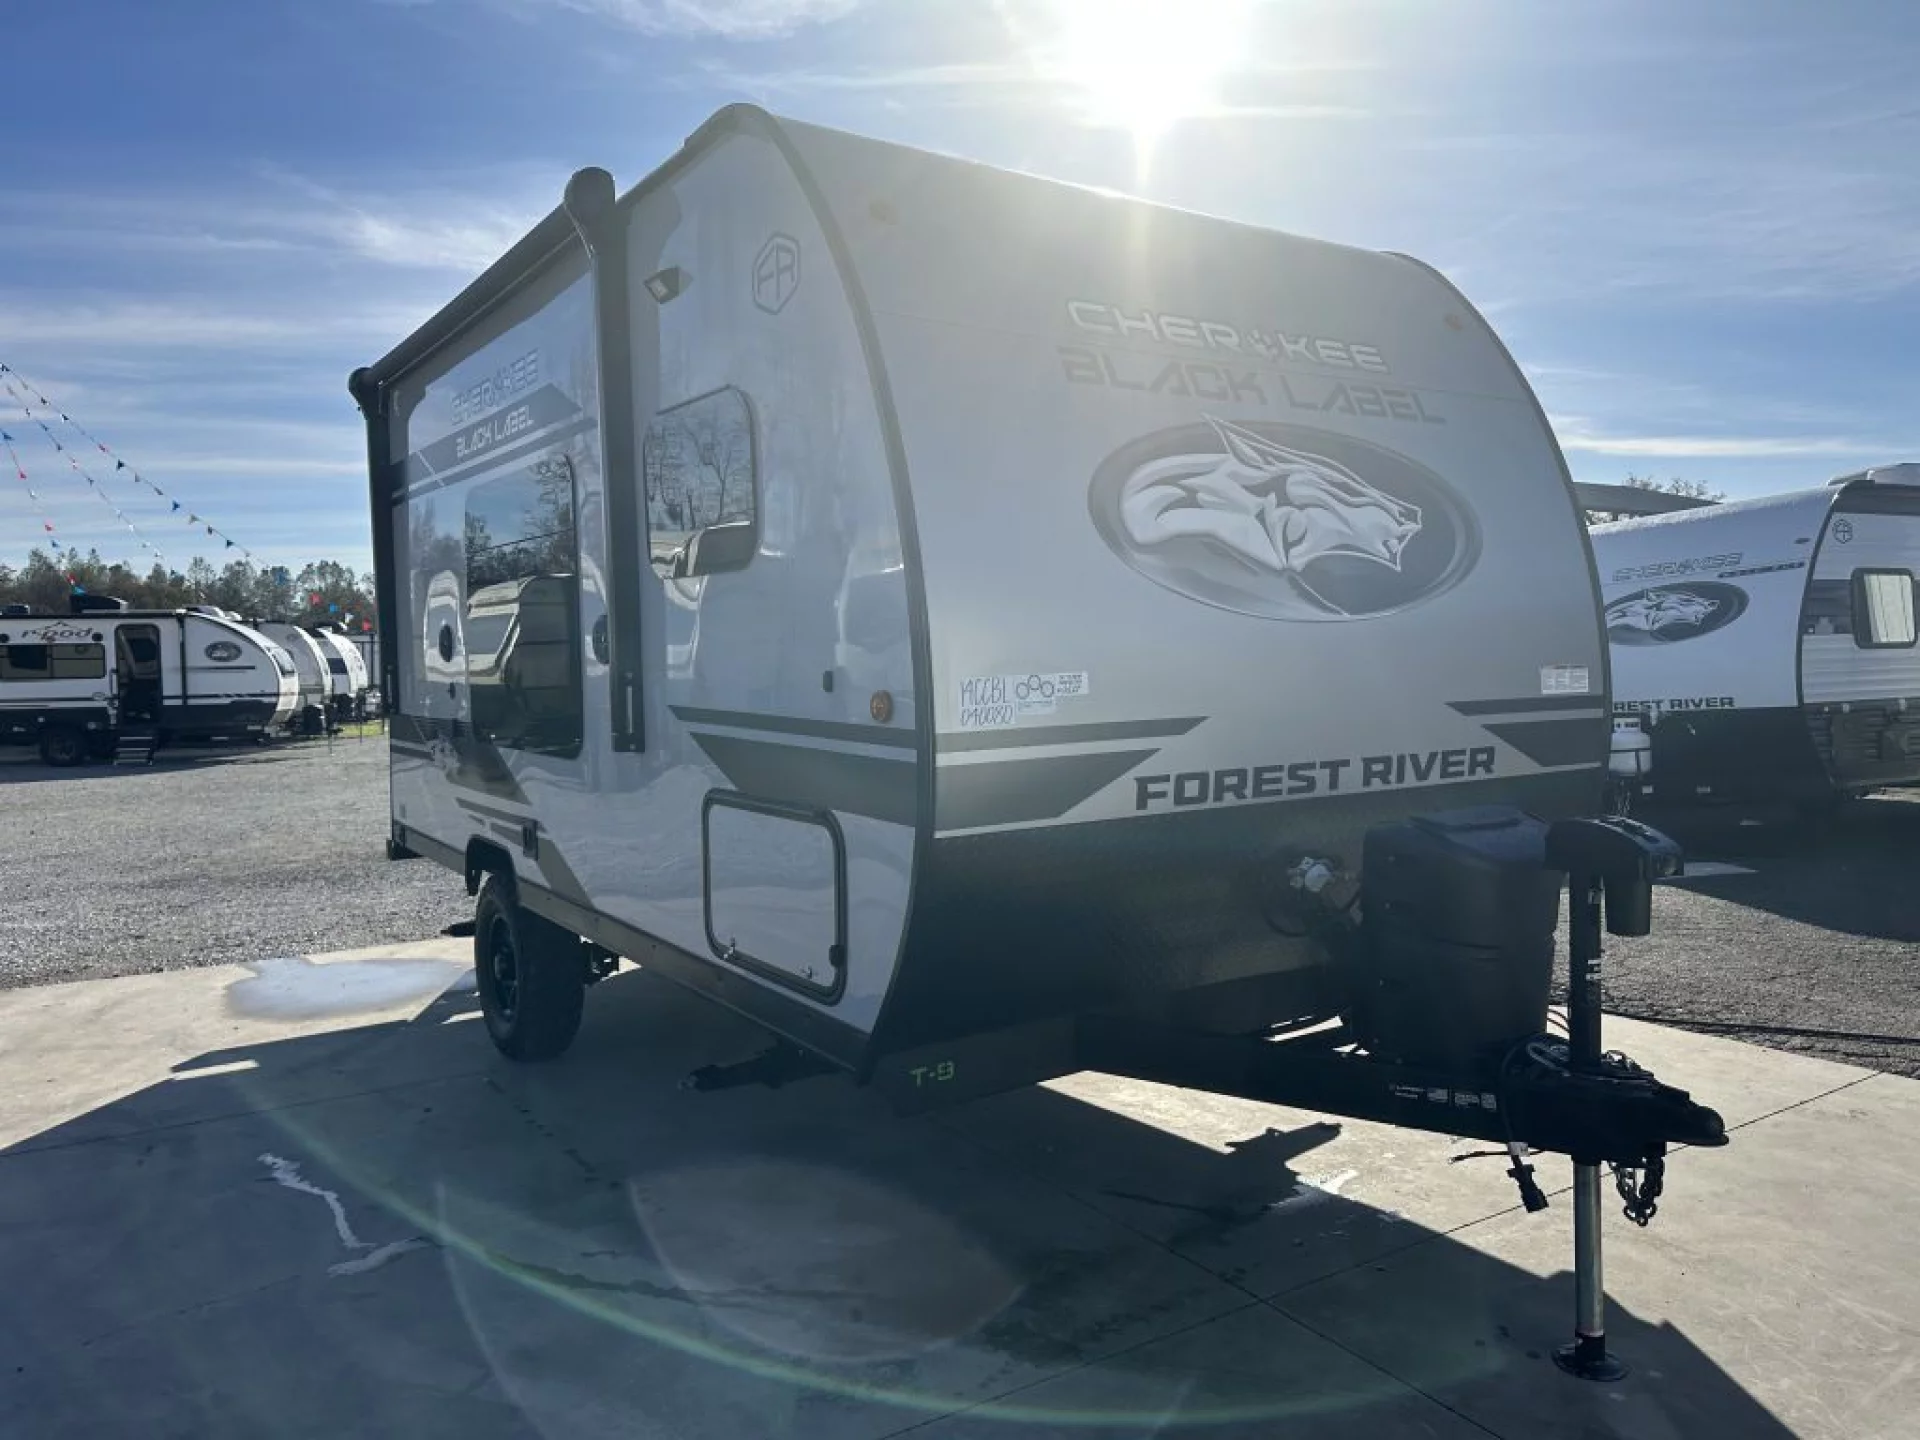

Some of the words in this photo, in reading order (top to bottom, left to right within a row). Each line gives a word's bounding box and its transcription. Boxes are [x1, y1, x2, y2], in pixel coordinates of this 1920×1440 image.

[1056, 345, 1270, 404] BLACK
[1278, 372, 1447, 424] LABEL
[456, 420, 493, 458] BLACK
[493, 404, 535, 441] LABEL
[1670, 696, 1735, 710] RIVER
[1134, 758, 1350, 811] FOREST
[1361, 746, 1496, 788] RIVER
